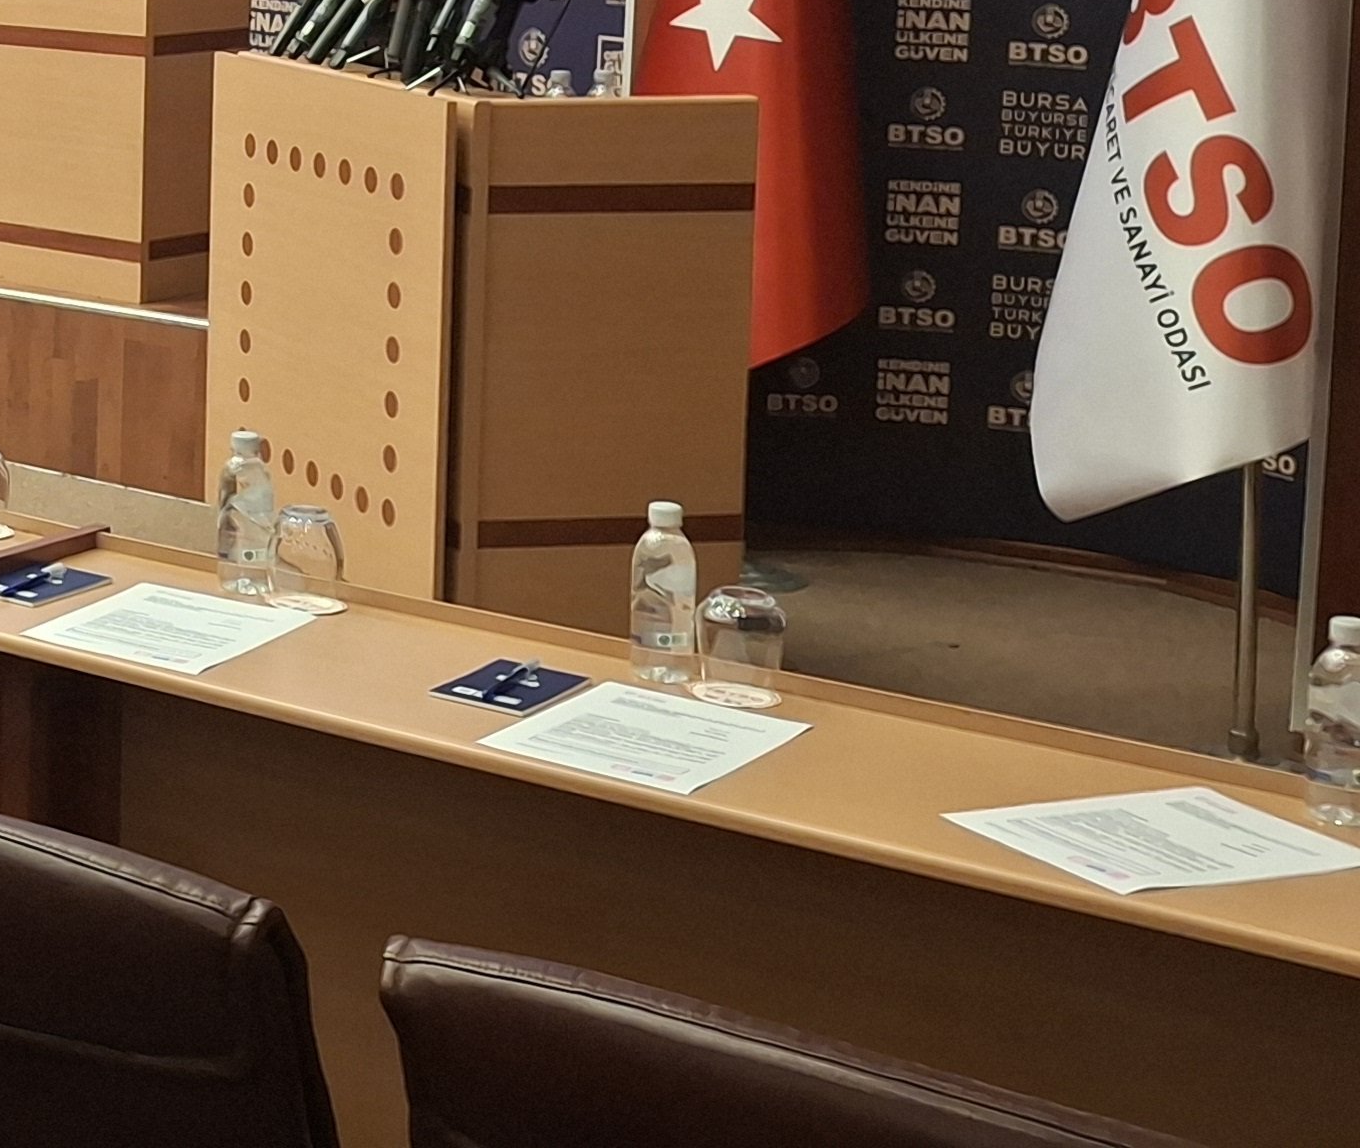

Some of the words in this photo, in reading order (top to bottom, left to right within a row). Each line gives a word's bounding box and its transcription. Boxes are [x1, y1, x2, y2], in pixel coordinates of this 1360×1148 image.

[1008, 41, 1088, 64] BTSO
[1002, 90, 1089, 113] BURSA
[887, 123, 965, 145] BTSO
[999, 138, 1086, 160] BÜYÜR
[1110, 166, 1132, 205] VE
[1156, 308, 1212, 392] ODASI
[880, 306, 956, 327] BTSO
[991, 306, 1043, 323] TÜRK
[989, 321, 1042, 340] BÜY
[767, 393, 839, 413] BTSO
[987, 405, 1029, 427] BT
